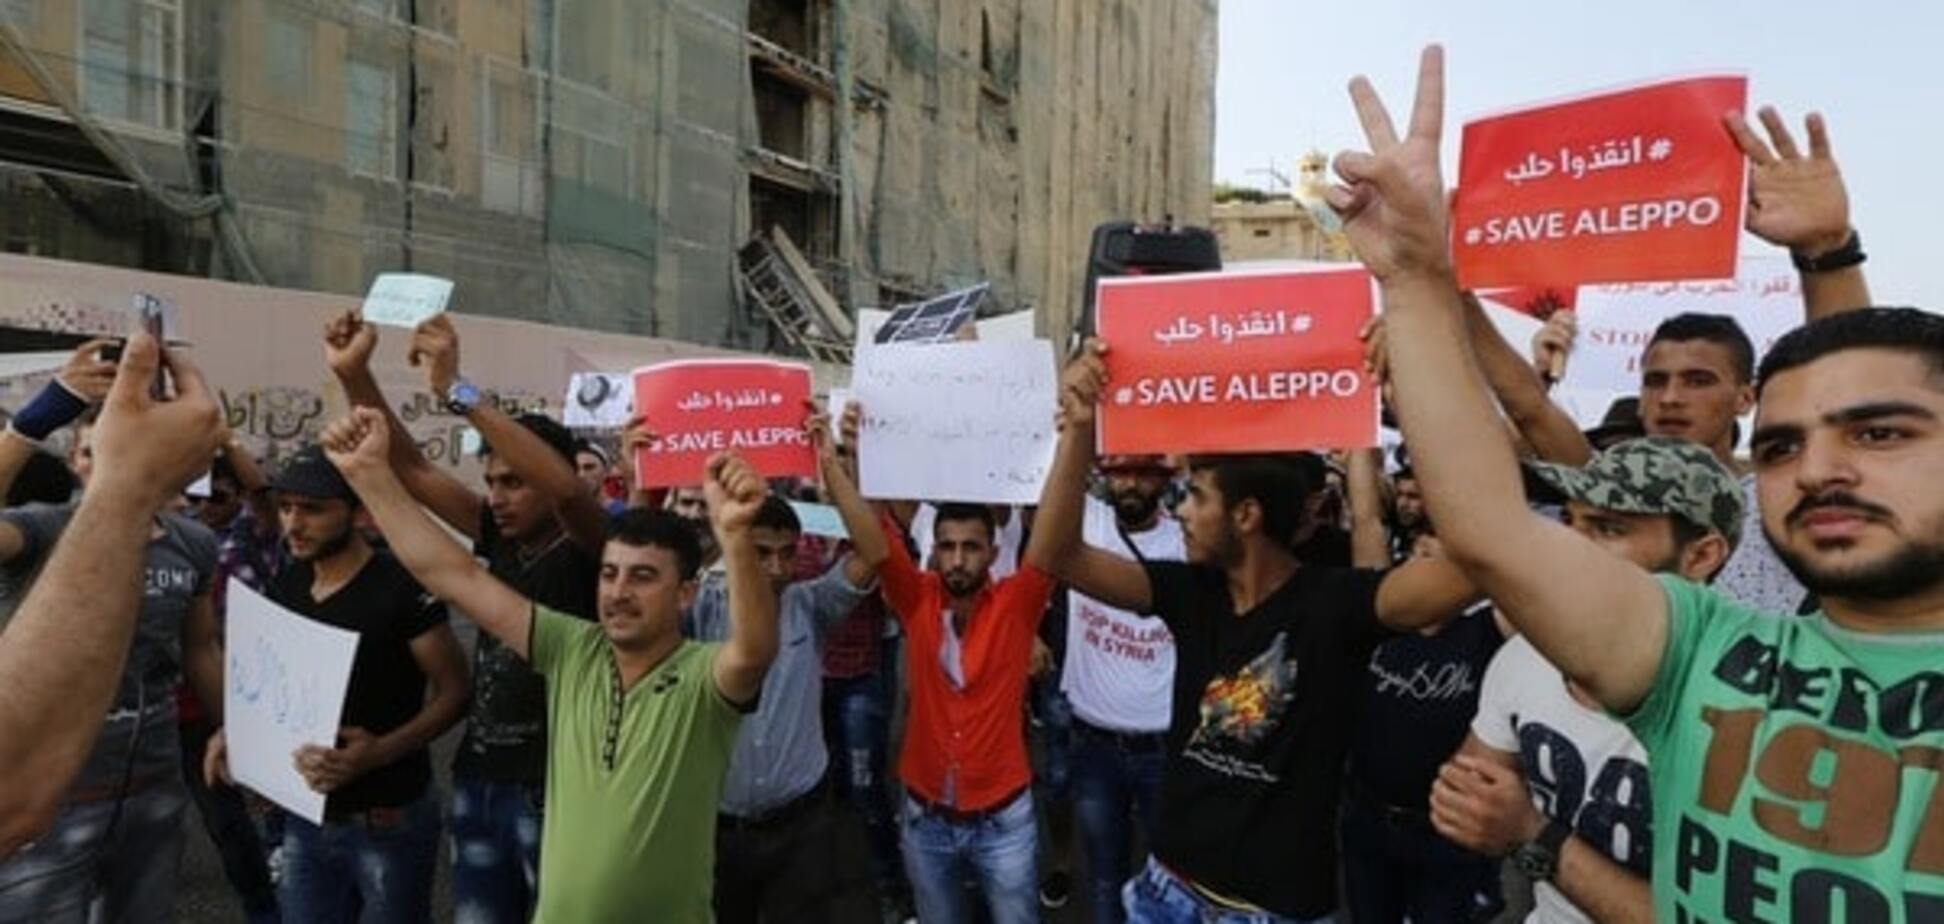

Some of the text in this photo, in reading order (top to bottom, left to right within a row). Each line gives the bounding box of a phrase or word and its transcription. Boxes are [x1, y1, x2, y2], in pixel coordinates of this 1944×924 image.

[1503, 153, 1554, 186] حلب
[1464, 196, 1720, 246] #SAVE ALEPPO
[1154, 317, 1203, 345] حلب
[1114, 369, 1360, 406] #SAVE ALEPPO
[1103, 638, 1155, 662] SYRIA
[1512, 715, 1653, 880] 98
[1674, 815, 1944, 924] PEO
